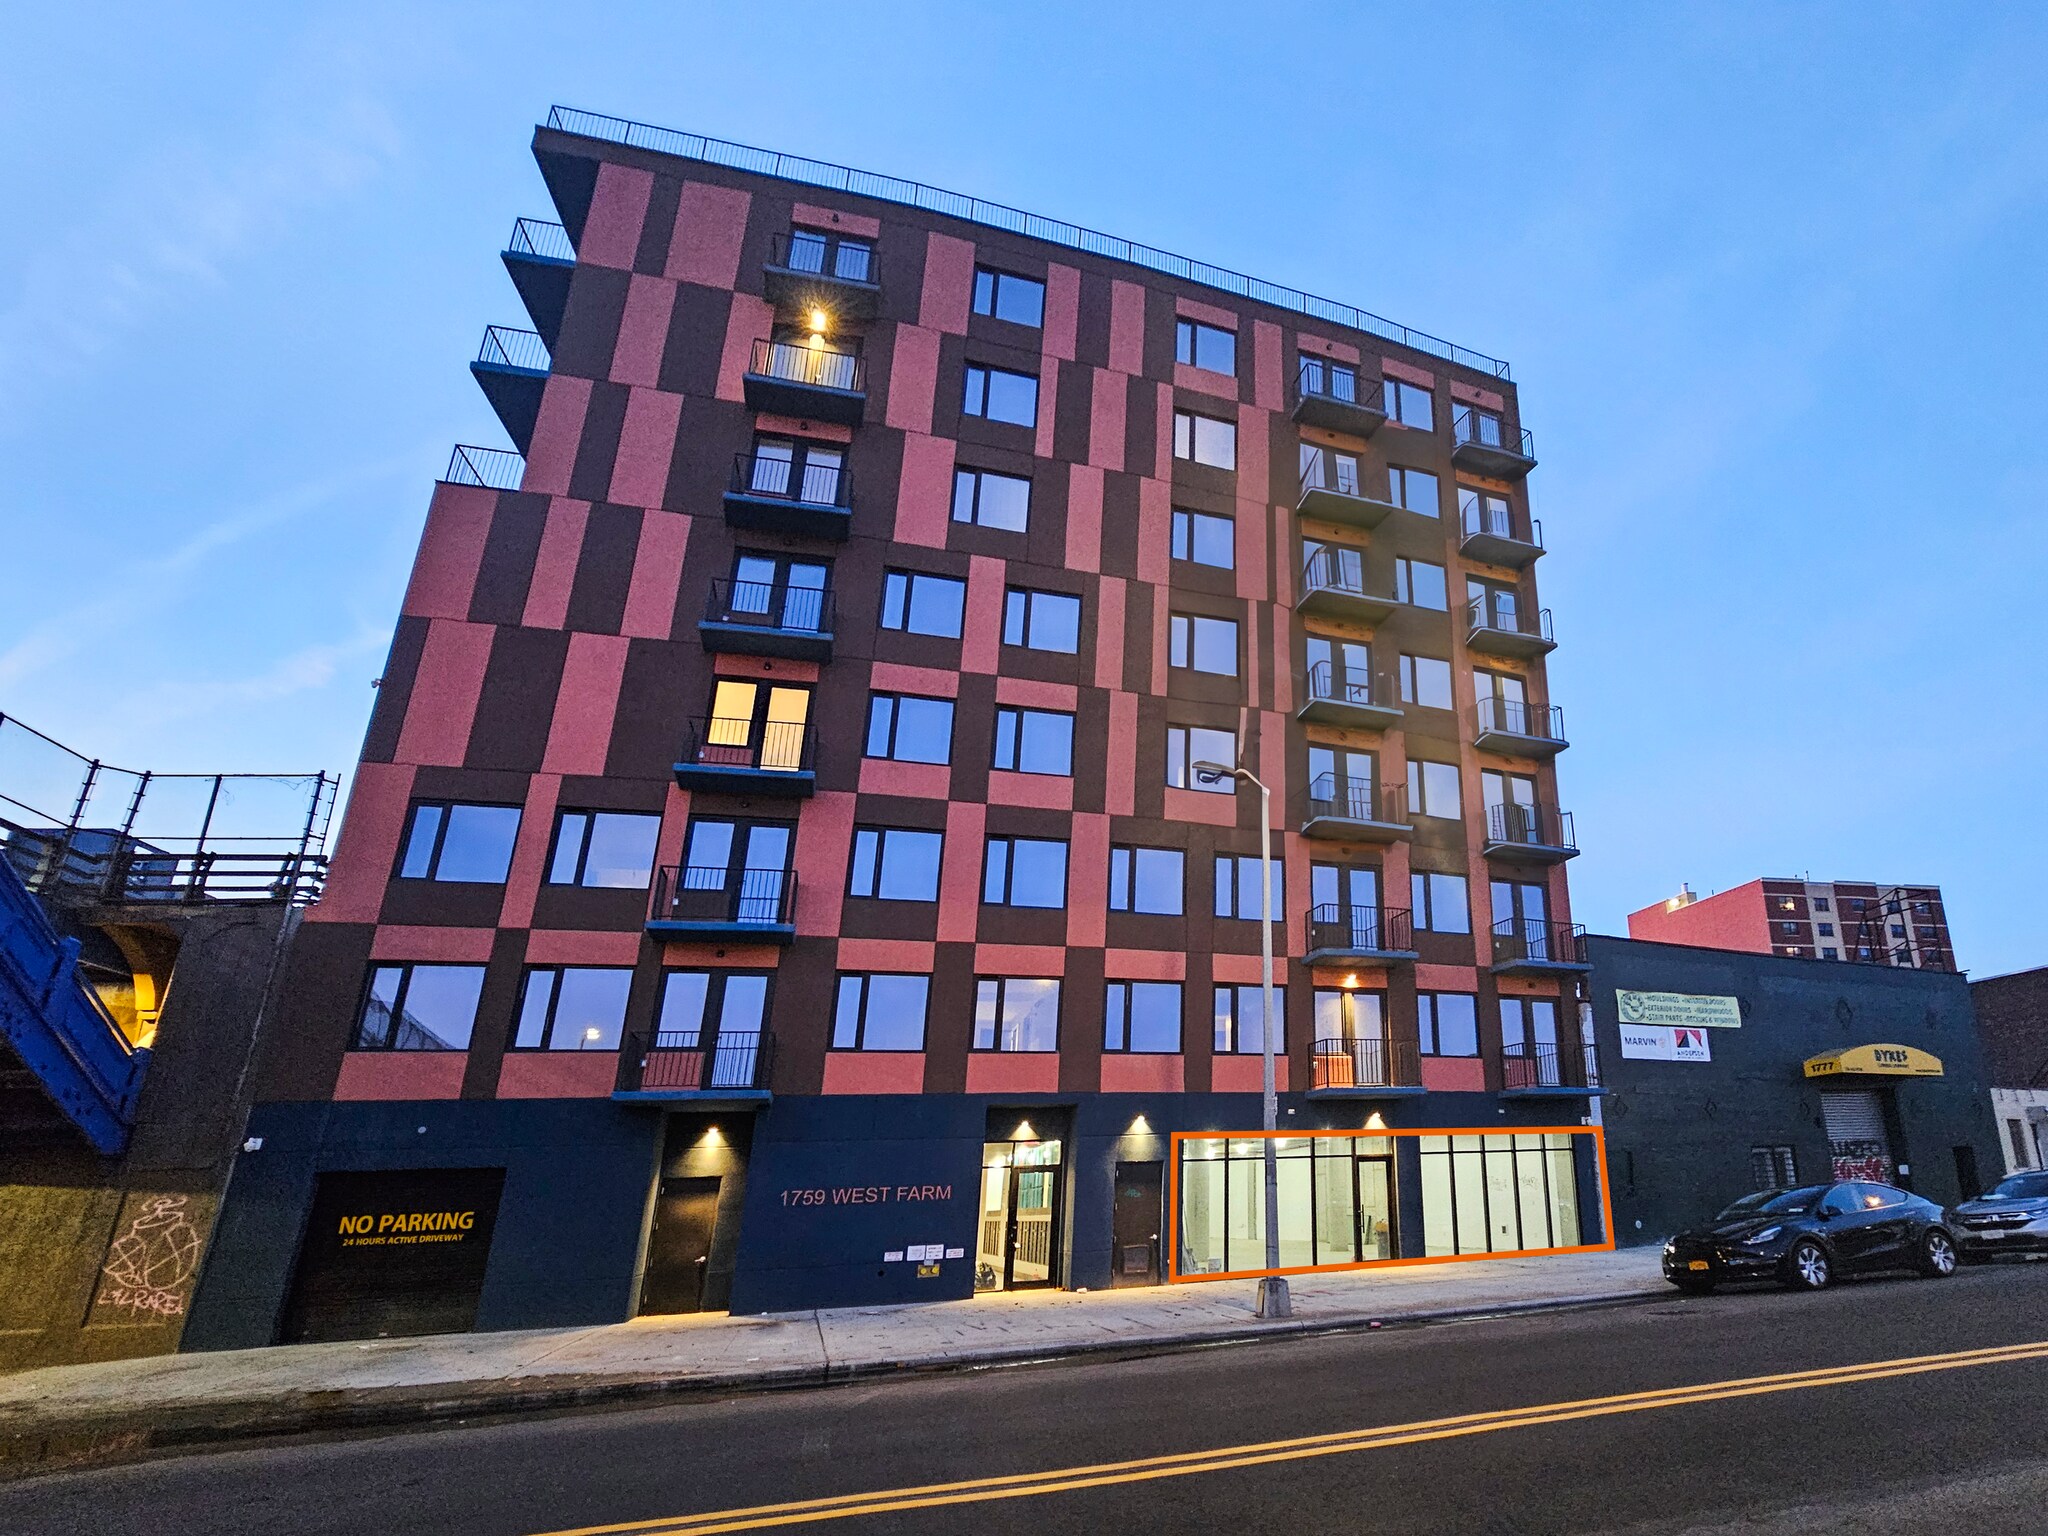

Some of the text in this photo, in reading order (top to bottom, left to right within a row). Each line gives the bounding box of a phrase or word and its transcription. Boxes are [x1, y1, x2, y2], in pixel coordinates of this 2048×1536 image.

[1624, 1036, 1657, 1046] MARVIN
[1810, 1062, 1834, 1073] 1777
[780, 1184, 952, 1207] 1759 WEST FARM
[338, 1211, 475, 1235] NO PARKING
[342, 1233, 465, 1247] 24 HOURS ACTIVE DRIVEWAY
